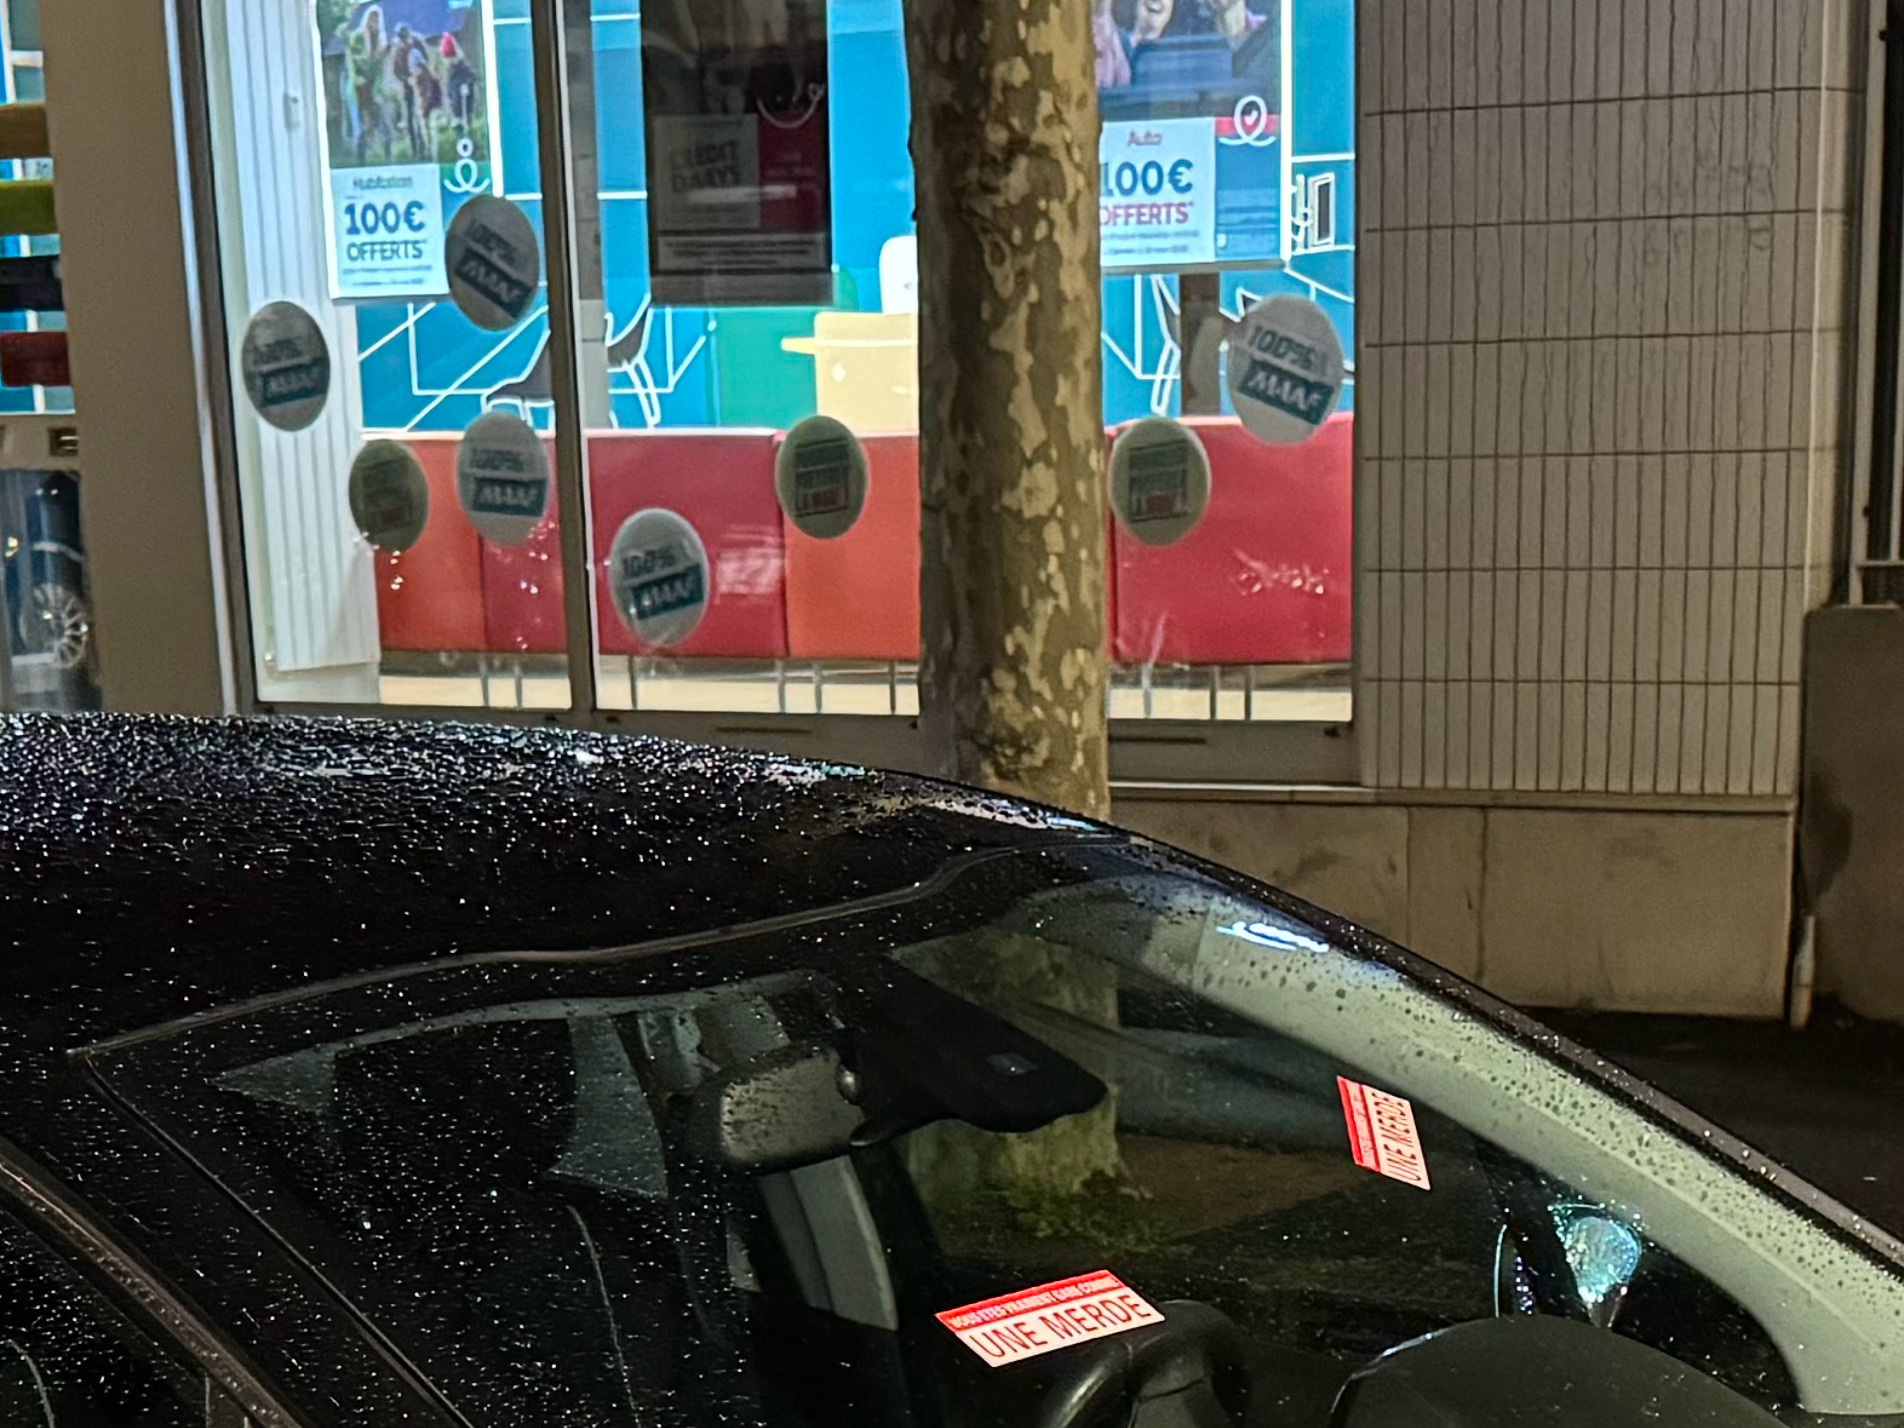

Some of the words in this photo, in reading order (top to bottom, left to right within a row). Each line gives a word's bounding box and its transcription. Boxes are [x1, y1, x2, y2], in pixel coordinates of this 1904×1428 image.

[344, 200, 426, 236] 100€
[1249, 325, 1316, 369] 100%
[969, 1321, 1049, 1358] UNE
[1038, 1294, 1151, 1340] MERDE
